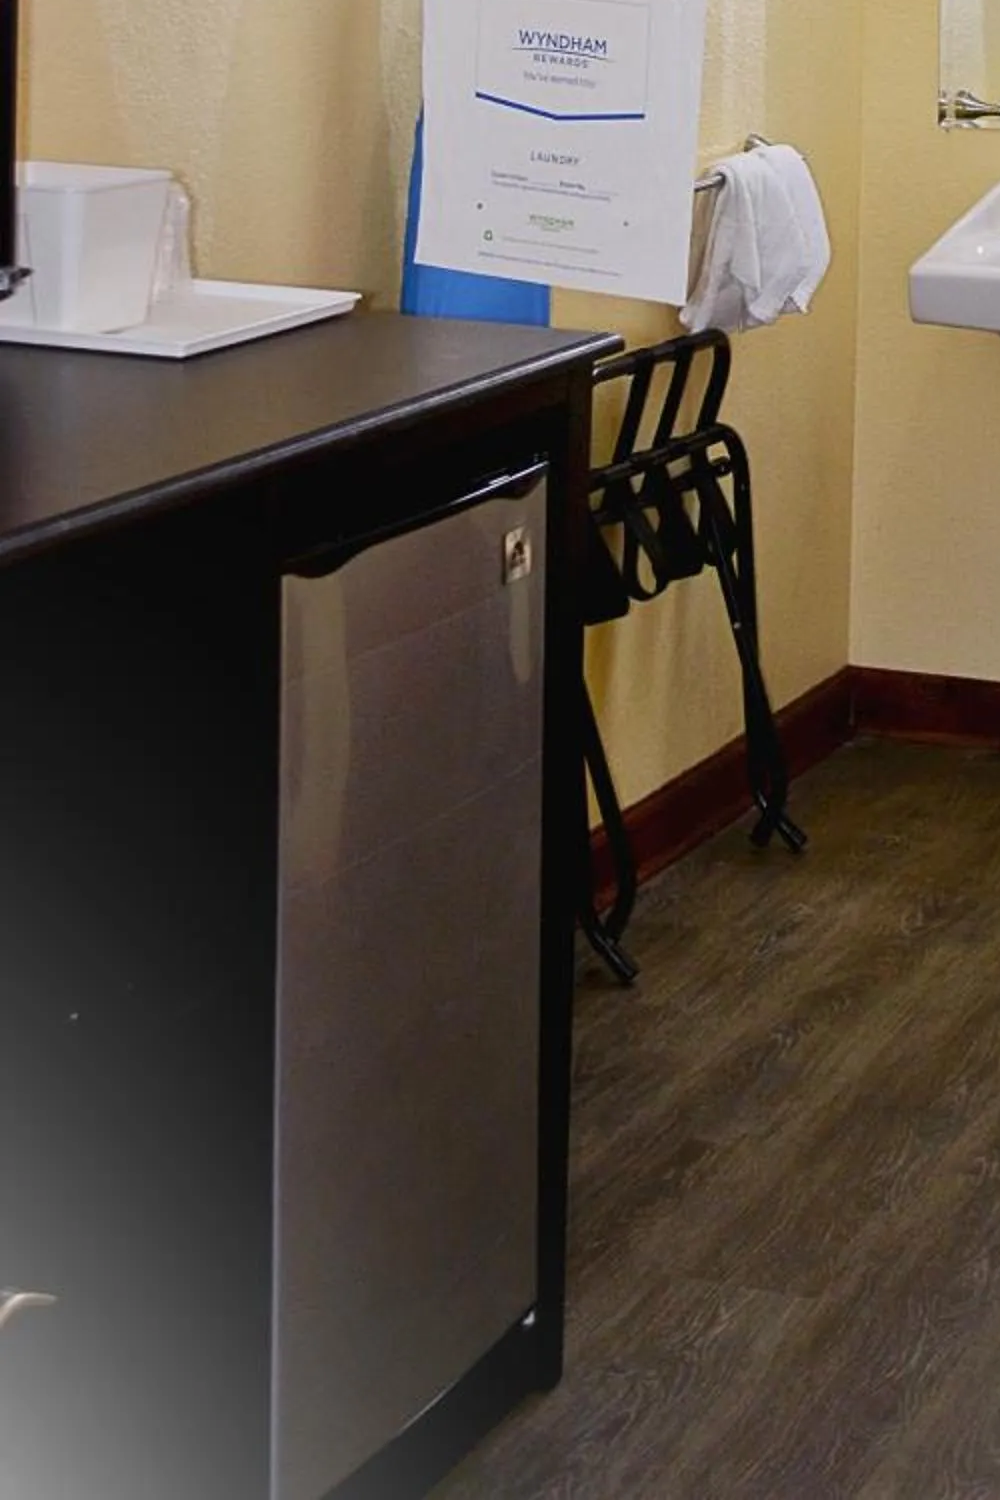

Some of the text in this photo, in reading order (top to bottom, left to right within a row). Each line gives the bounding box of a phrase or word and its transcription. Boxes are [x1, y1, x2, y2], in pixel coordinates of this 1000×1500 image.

[518, 29, 608, 53] WYNDHAM
[533, 53, 589, 68] REWARDS
[530, 150, 580, 165] LAUNDRY
